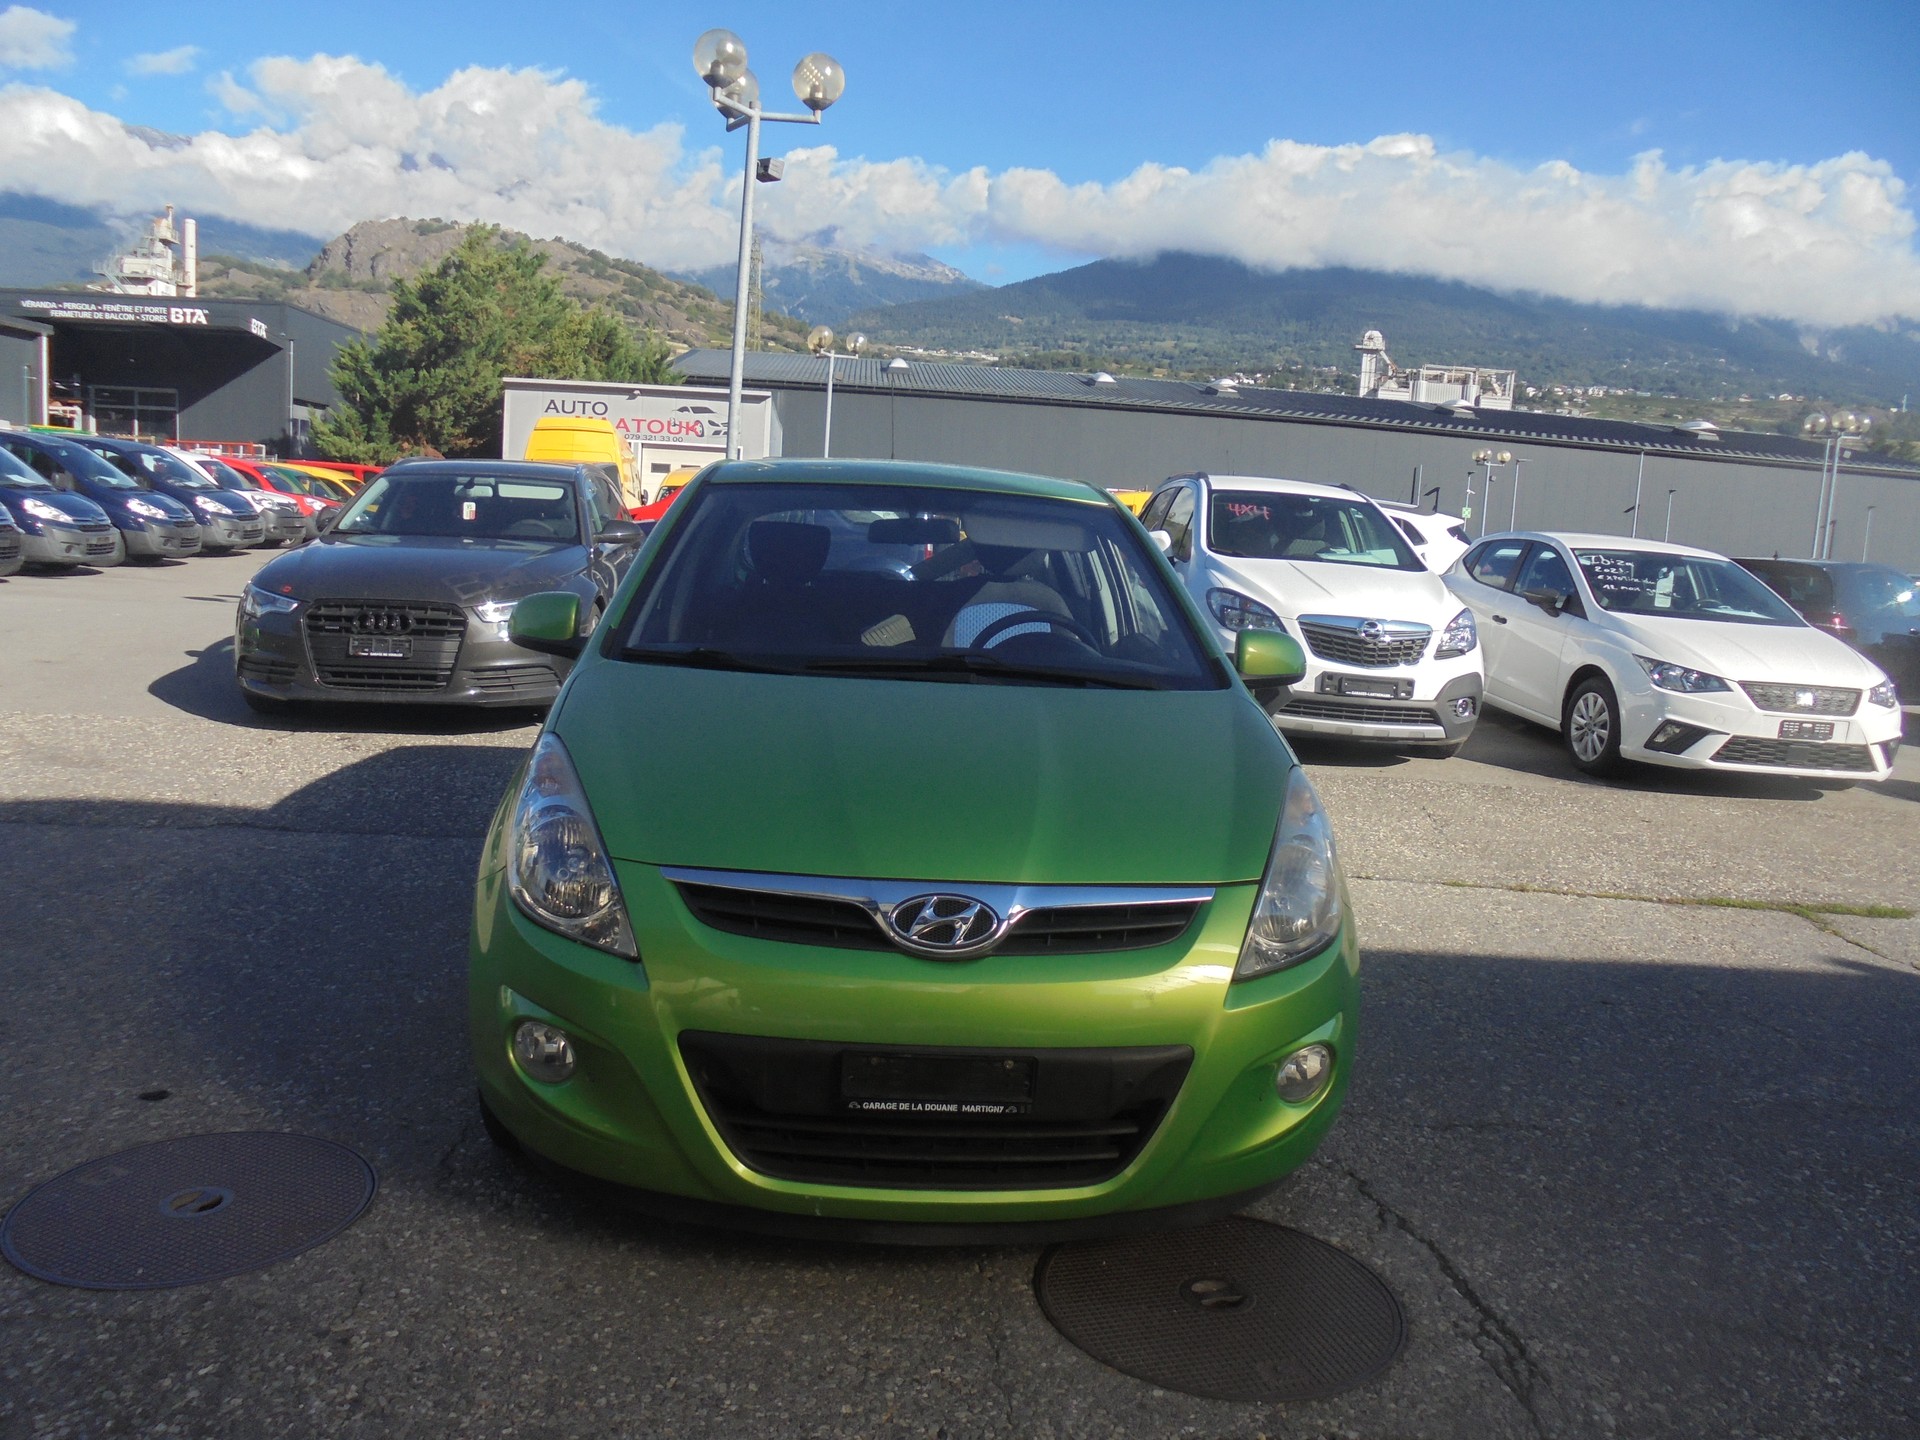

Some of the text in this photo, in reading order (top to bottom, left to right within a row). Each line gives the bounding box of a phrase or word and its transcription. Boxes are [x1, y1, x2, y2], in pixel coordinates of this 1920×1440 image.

[21, 300, 57, 308] VÉRANDA
[63, 302, 96, 310] PERGOLA
[103, 304, 133, 313] FENÊTRE
[145, 306, 168, 315] PORTE
[50, 310, 168, 323] FERMETURE DE BALCON STORES
[170, 307, 208, 325] BTA
[544, 399, 608, 416] AUTO
[575, 416, 700, 437] ATOUK
[624, 433, 640, 441] 079
[863, 1102, 897, 1110] GARAGE
[912, 1103, 923, 1111] LA
[924, 1103, 958, 1112] DOUANE
